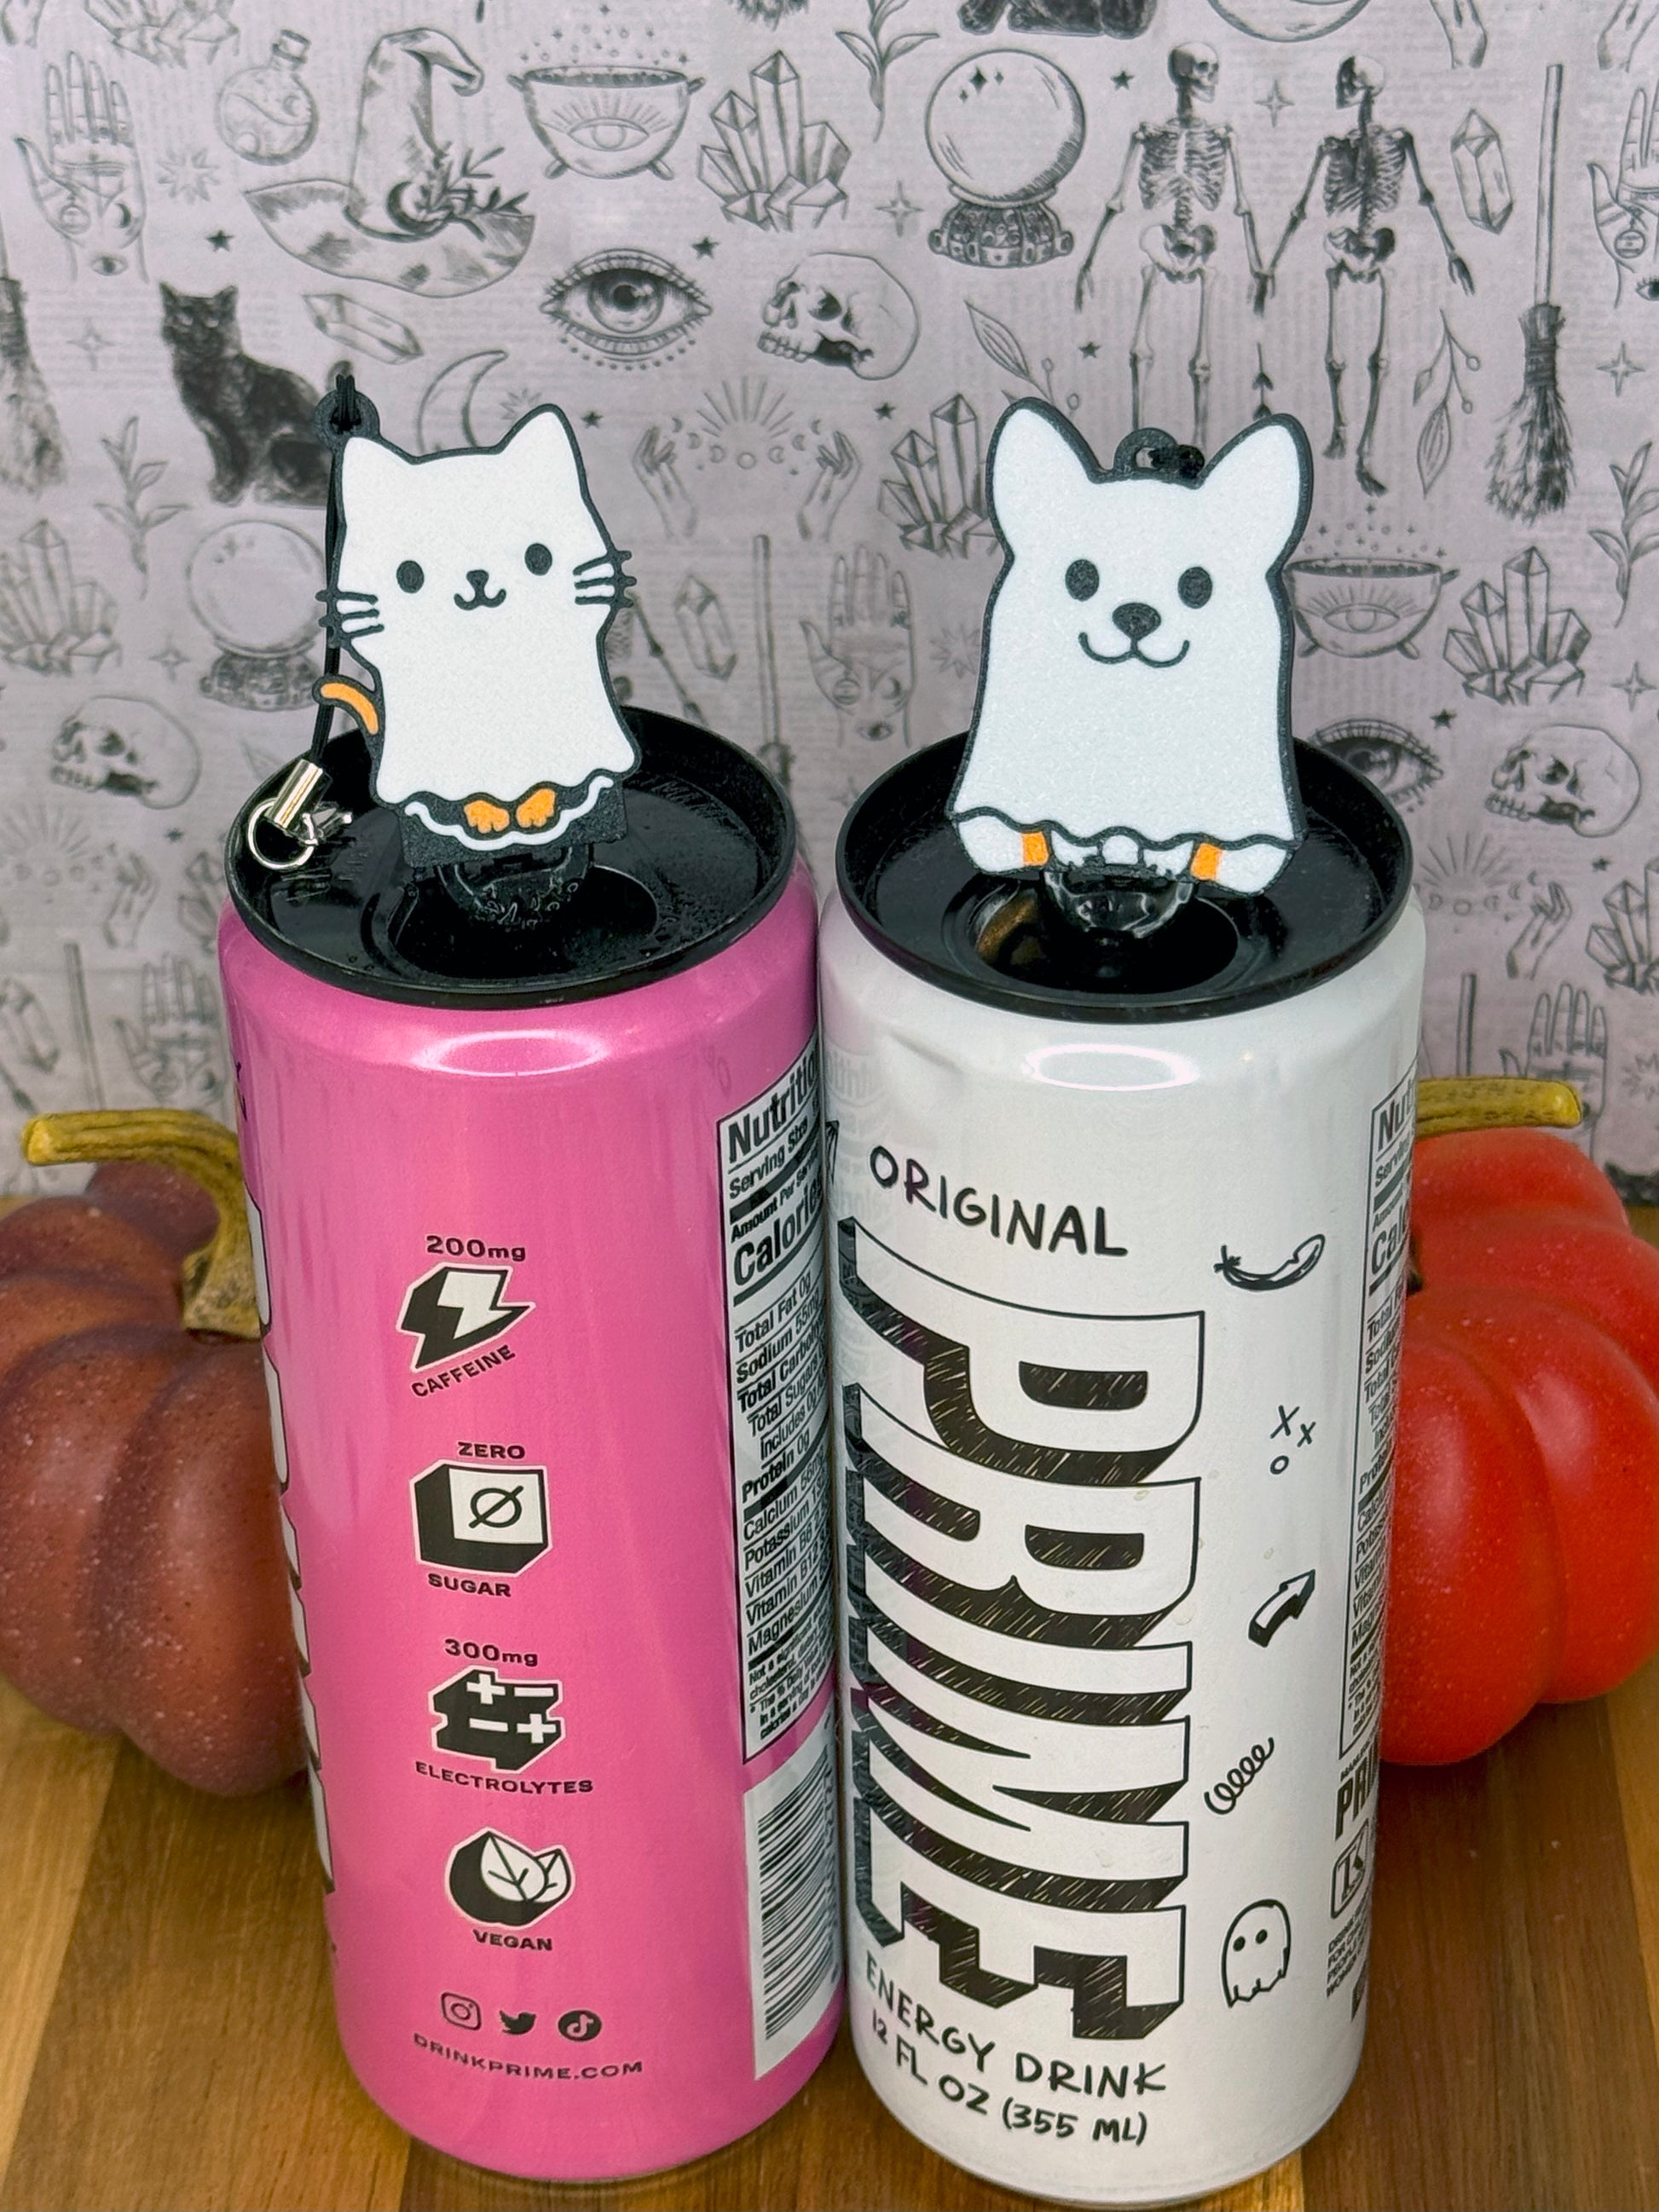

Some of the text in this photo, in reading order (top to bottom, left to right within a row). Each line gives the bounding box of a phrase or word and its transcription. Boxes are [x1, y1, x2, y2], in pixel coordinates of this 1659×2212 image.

[869, 1145, 1128, 1257] ORIGINAL
[425, 1234, 527, 1262] 200mg
[735, 1311, 774, 1353] Total
[777, 1288, 798, 1323] Fat
[410, 1343, 516, 1397] CAFFEINE
[736, 1328, 793, 1384] Sodium
[737, 1369, 776, 1414] Total
[748, 1395, 782, 1437] Total
[785, 1354, 818, 1407] Sugars
[457, 1441, 526, 1460] ZERO
[760, 1406, 806, 1460] Includes
[742, 1447, 795, 1504] Protein
[796, 1428, 811, 1456] 0g
[743, 1486, 798, 1542] Calcium
[745, 1499, 810, 1571] Potassium
[427, 1572, 512, 1597] SUGAR
[744, 1544, 797, 1598] Vitamin
[745, 1573, 798, 1626] Vitamin
[801, 1543, 819, 1582] B12
[748, 1573, 818, 1656] Magnesium
[836, 1216, 1206, 2040] PRIME
[443, 1637, 539, 1667] 300mg
[415, 1760, 594, 1794] ELECTROLYTES
[472, 1928, 553, 1952] VEGAN
[865, 1949, 1167, 2099] ENERGY DRINK
[412, 2030, 644, 2081] DRINKPRIME.COM
[870, 2009, 1148, 2146] 12 FL OZ (355 ML)
